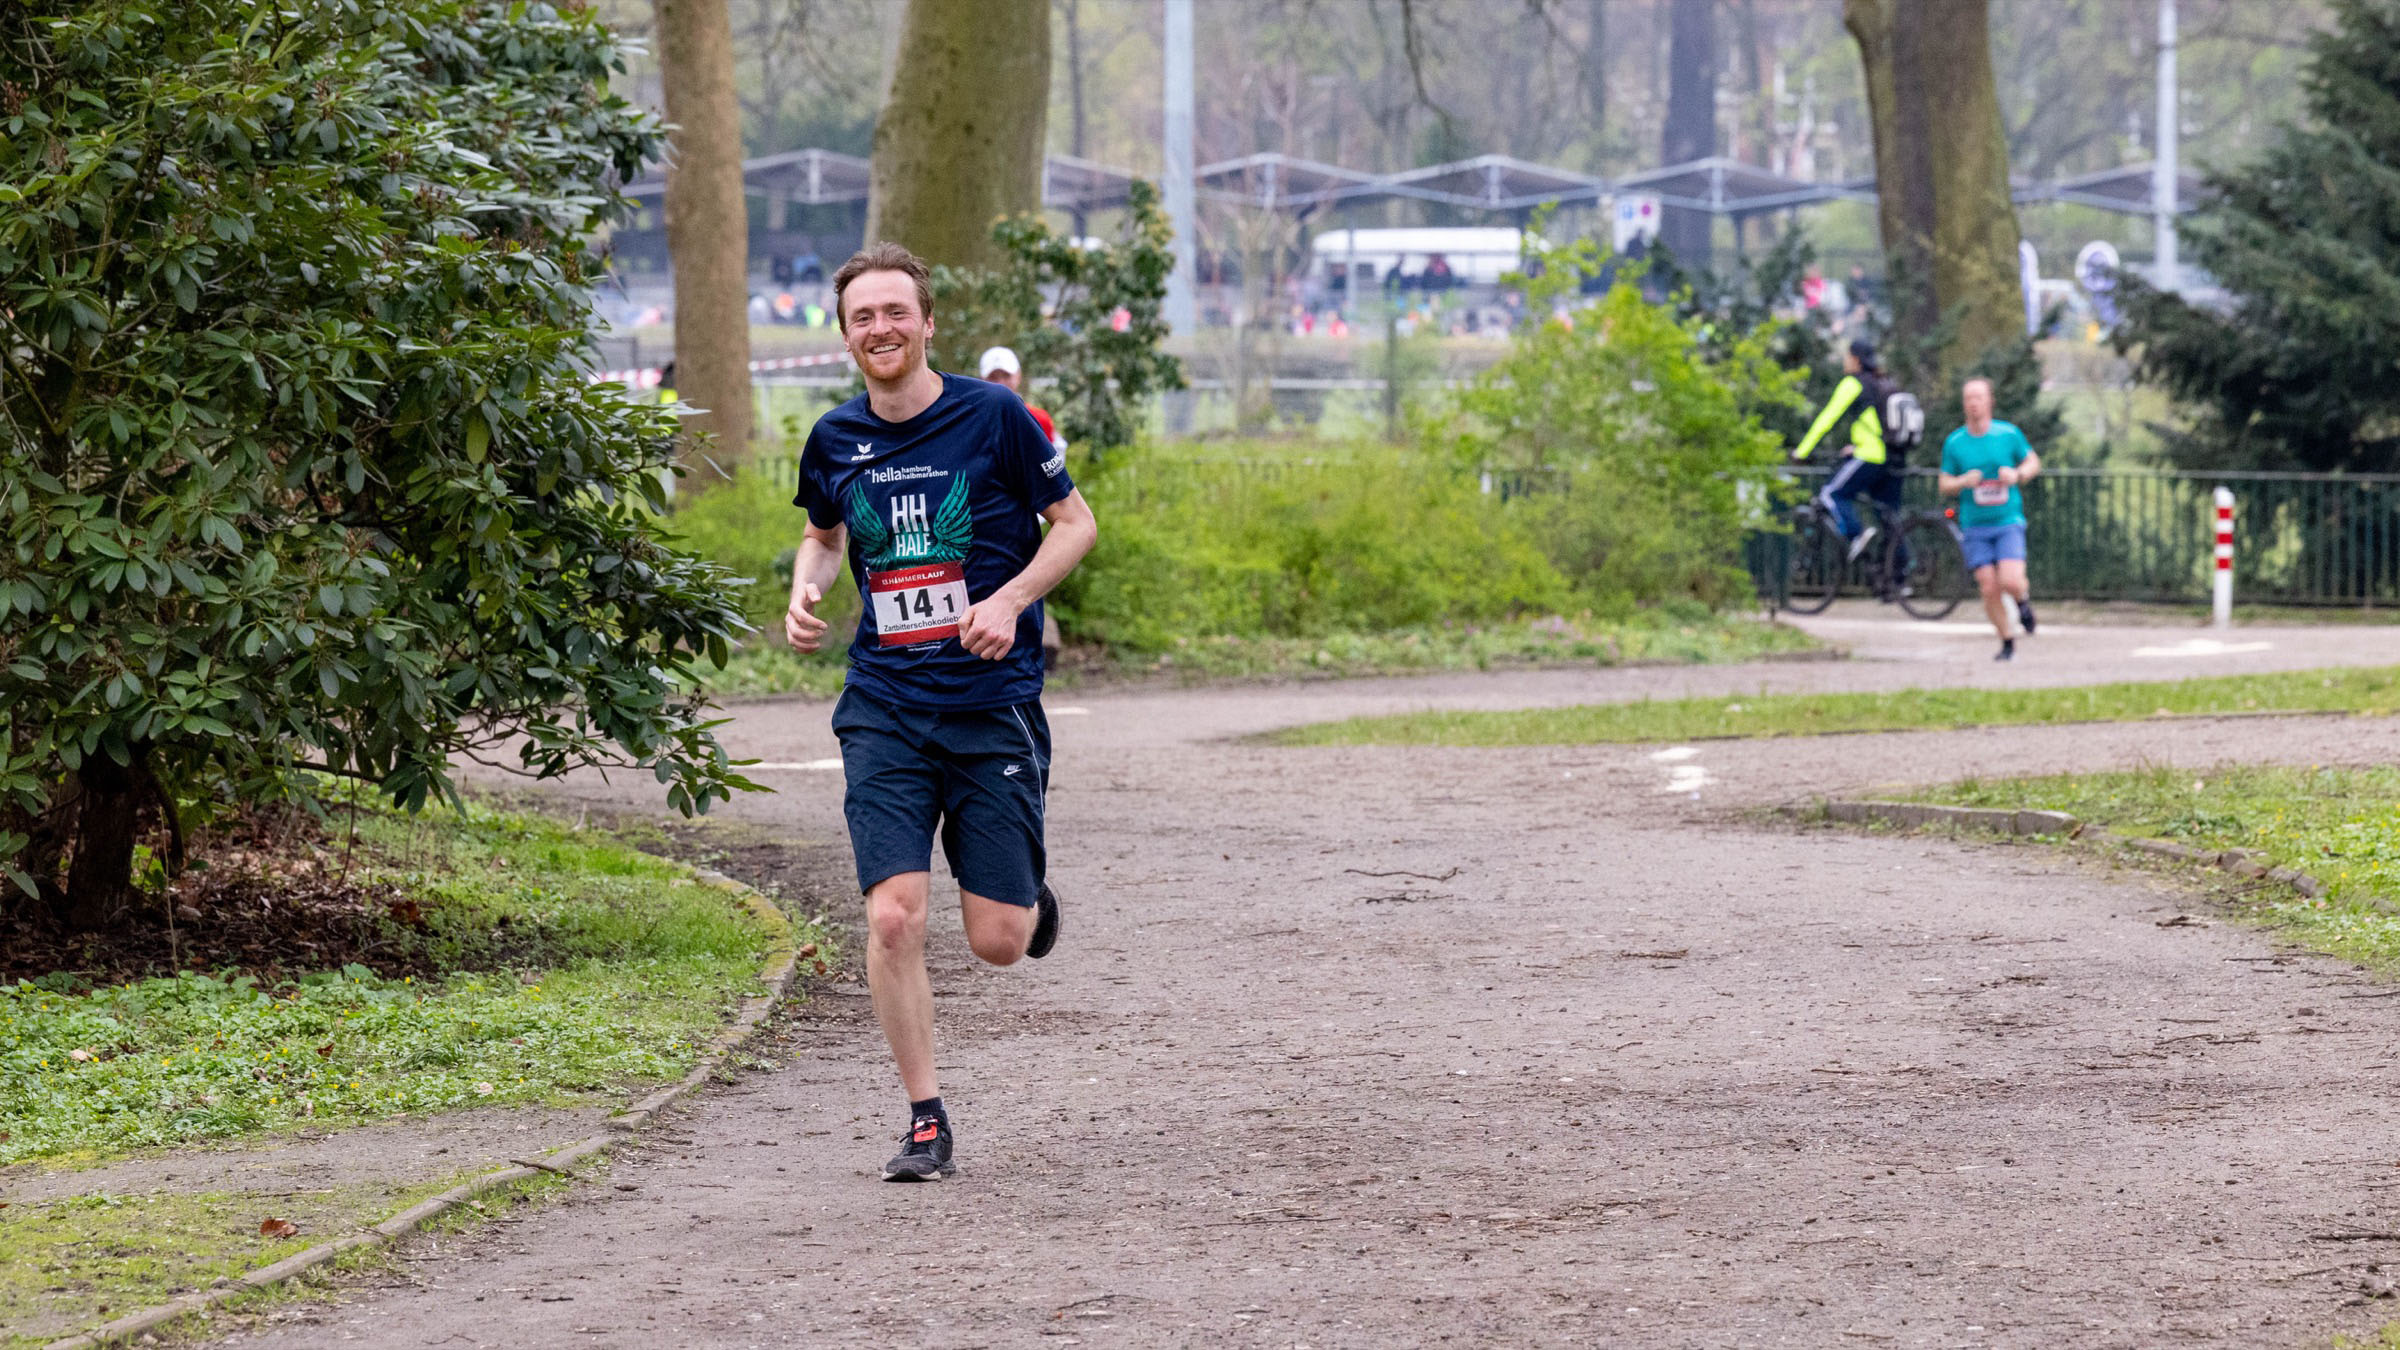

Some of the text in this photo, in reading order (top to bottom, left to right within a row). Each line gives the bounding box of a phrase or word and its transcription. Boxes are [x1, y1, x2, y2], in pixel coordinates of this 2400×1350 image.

[872, 467, 902, 483] hella
[901, 465, 932, 473] hamburg
[902, 470, 949, 480] halbmarathon
[891, 493, 929, 534] HH
[896, 533, 931, 557] HALF
[893, 588, 955, 621] 14 1
